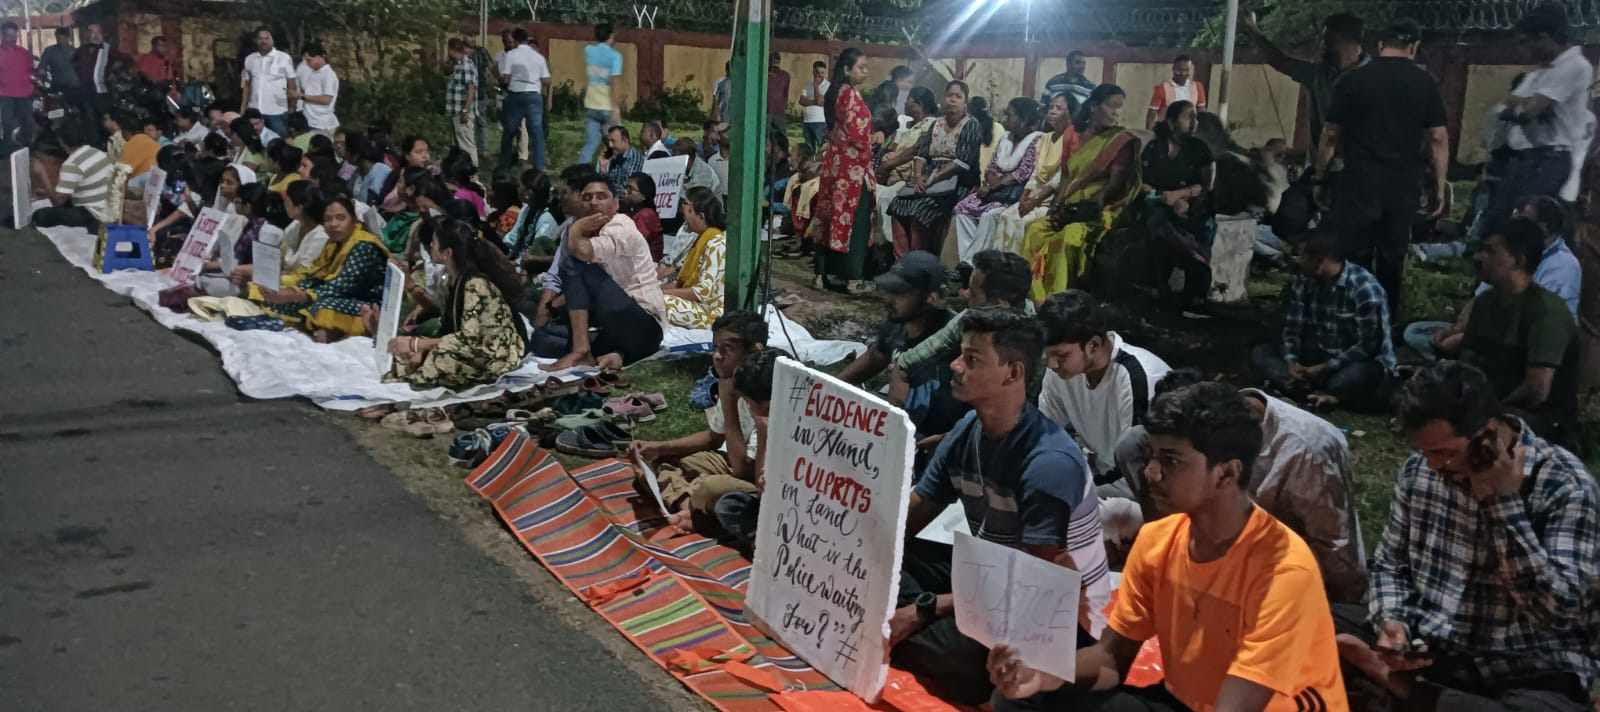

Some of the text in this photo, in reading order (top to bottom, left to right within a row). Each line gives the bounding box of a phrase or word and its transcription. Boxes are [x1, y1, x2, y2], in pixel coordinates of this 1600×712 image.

[792, 416, 815, 446] in
[794, 456, 871, 513] CULPRITS
[772, 543, 819, 594] Police
[777, 507, 867, 580] What is the
